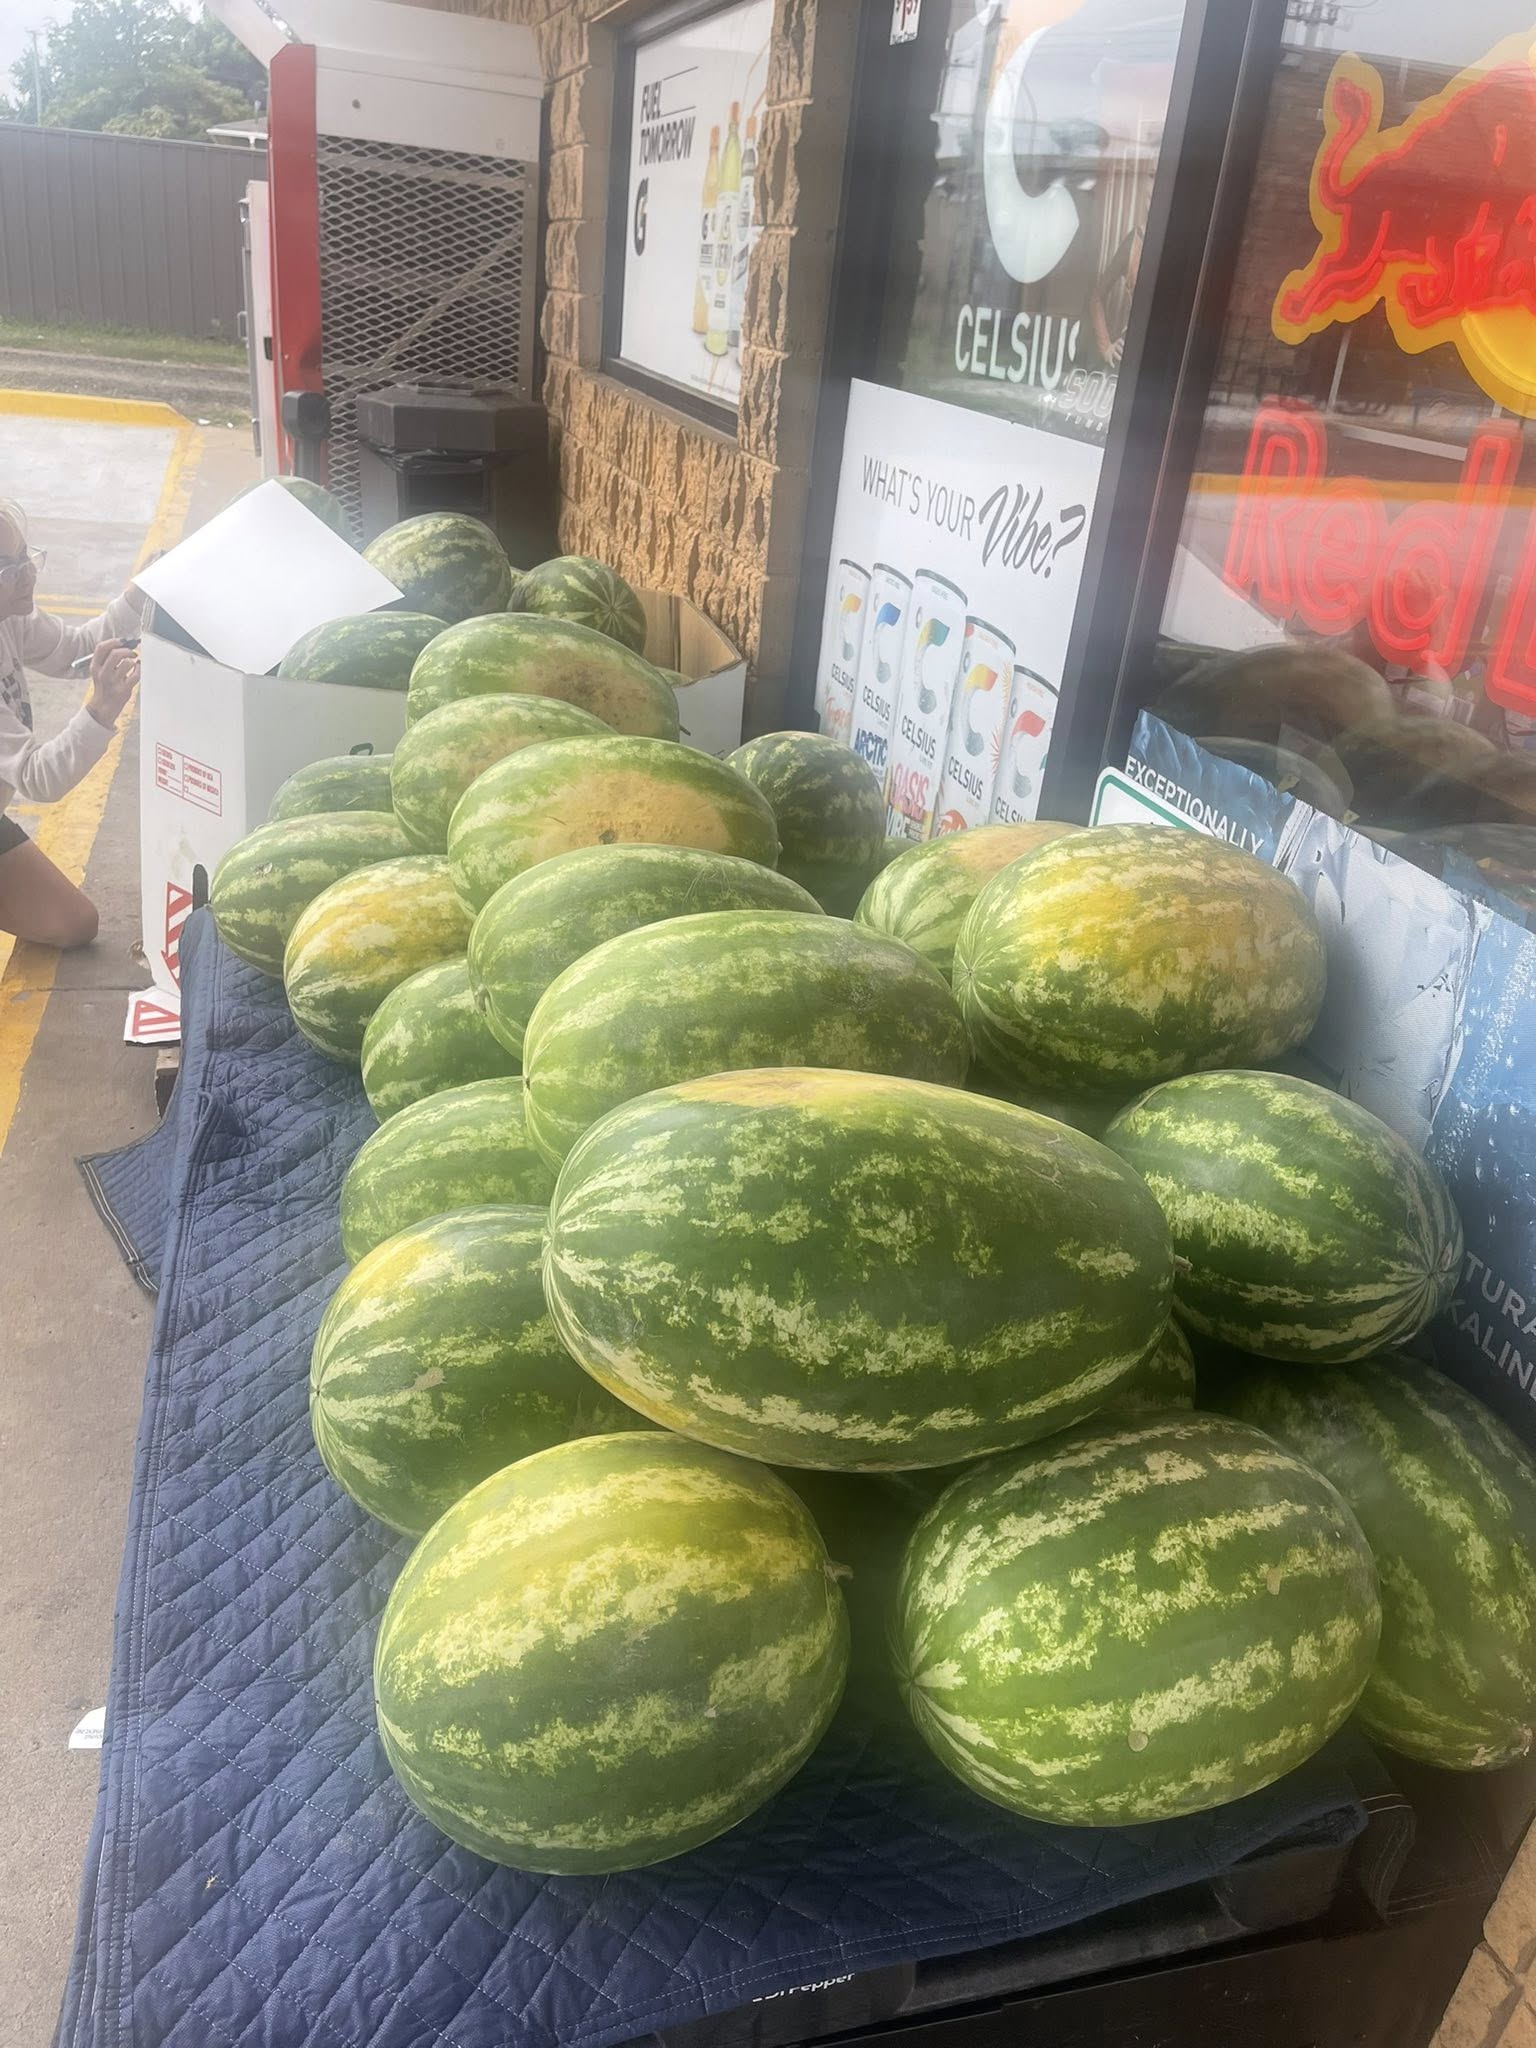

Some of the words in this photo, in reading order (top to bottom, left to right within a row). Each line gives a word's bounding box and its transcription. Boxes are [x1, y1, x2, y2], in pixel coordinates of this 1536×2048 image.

[641, 80, 663, 123] FUEL
[639, 116, 696, 167] TOMORROW
[862, 454, 923, 516] WHAT'S
[926, 479, 975, 541] YOUR
[978, 482, 1086, 580] Vibe?
[1222, 398, 1521, 681] Red
[831, 663, 855, 694] CELSIUS
[862, 685, 891, 722] CELSIUS
[854, 727, 889, 767] ARCTIC
[901, 714, 936, 760] CELSIUS
[948, 755, 984, 801] CELSIUS
